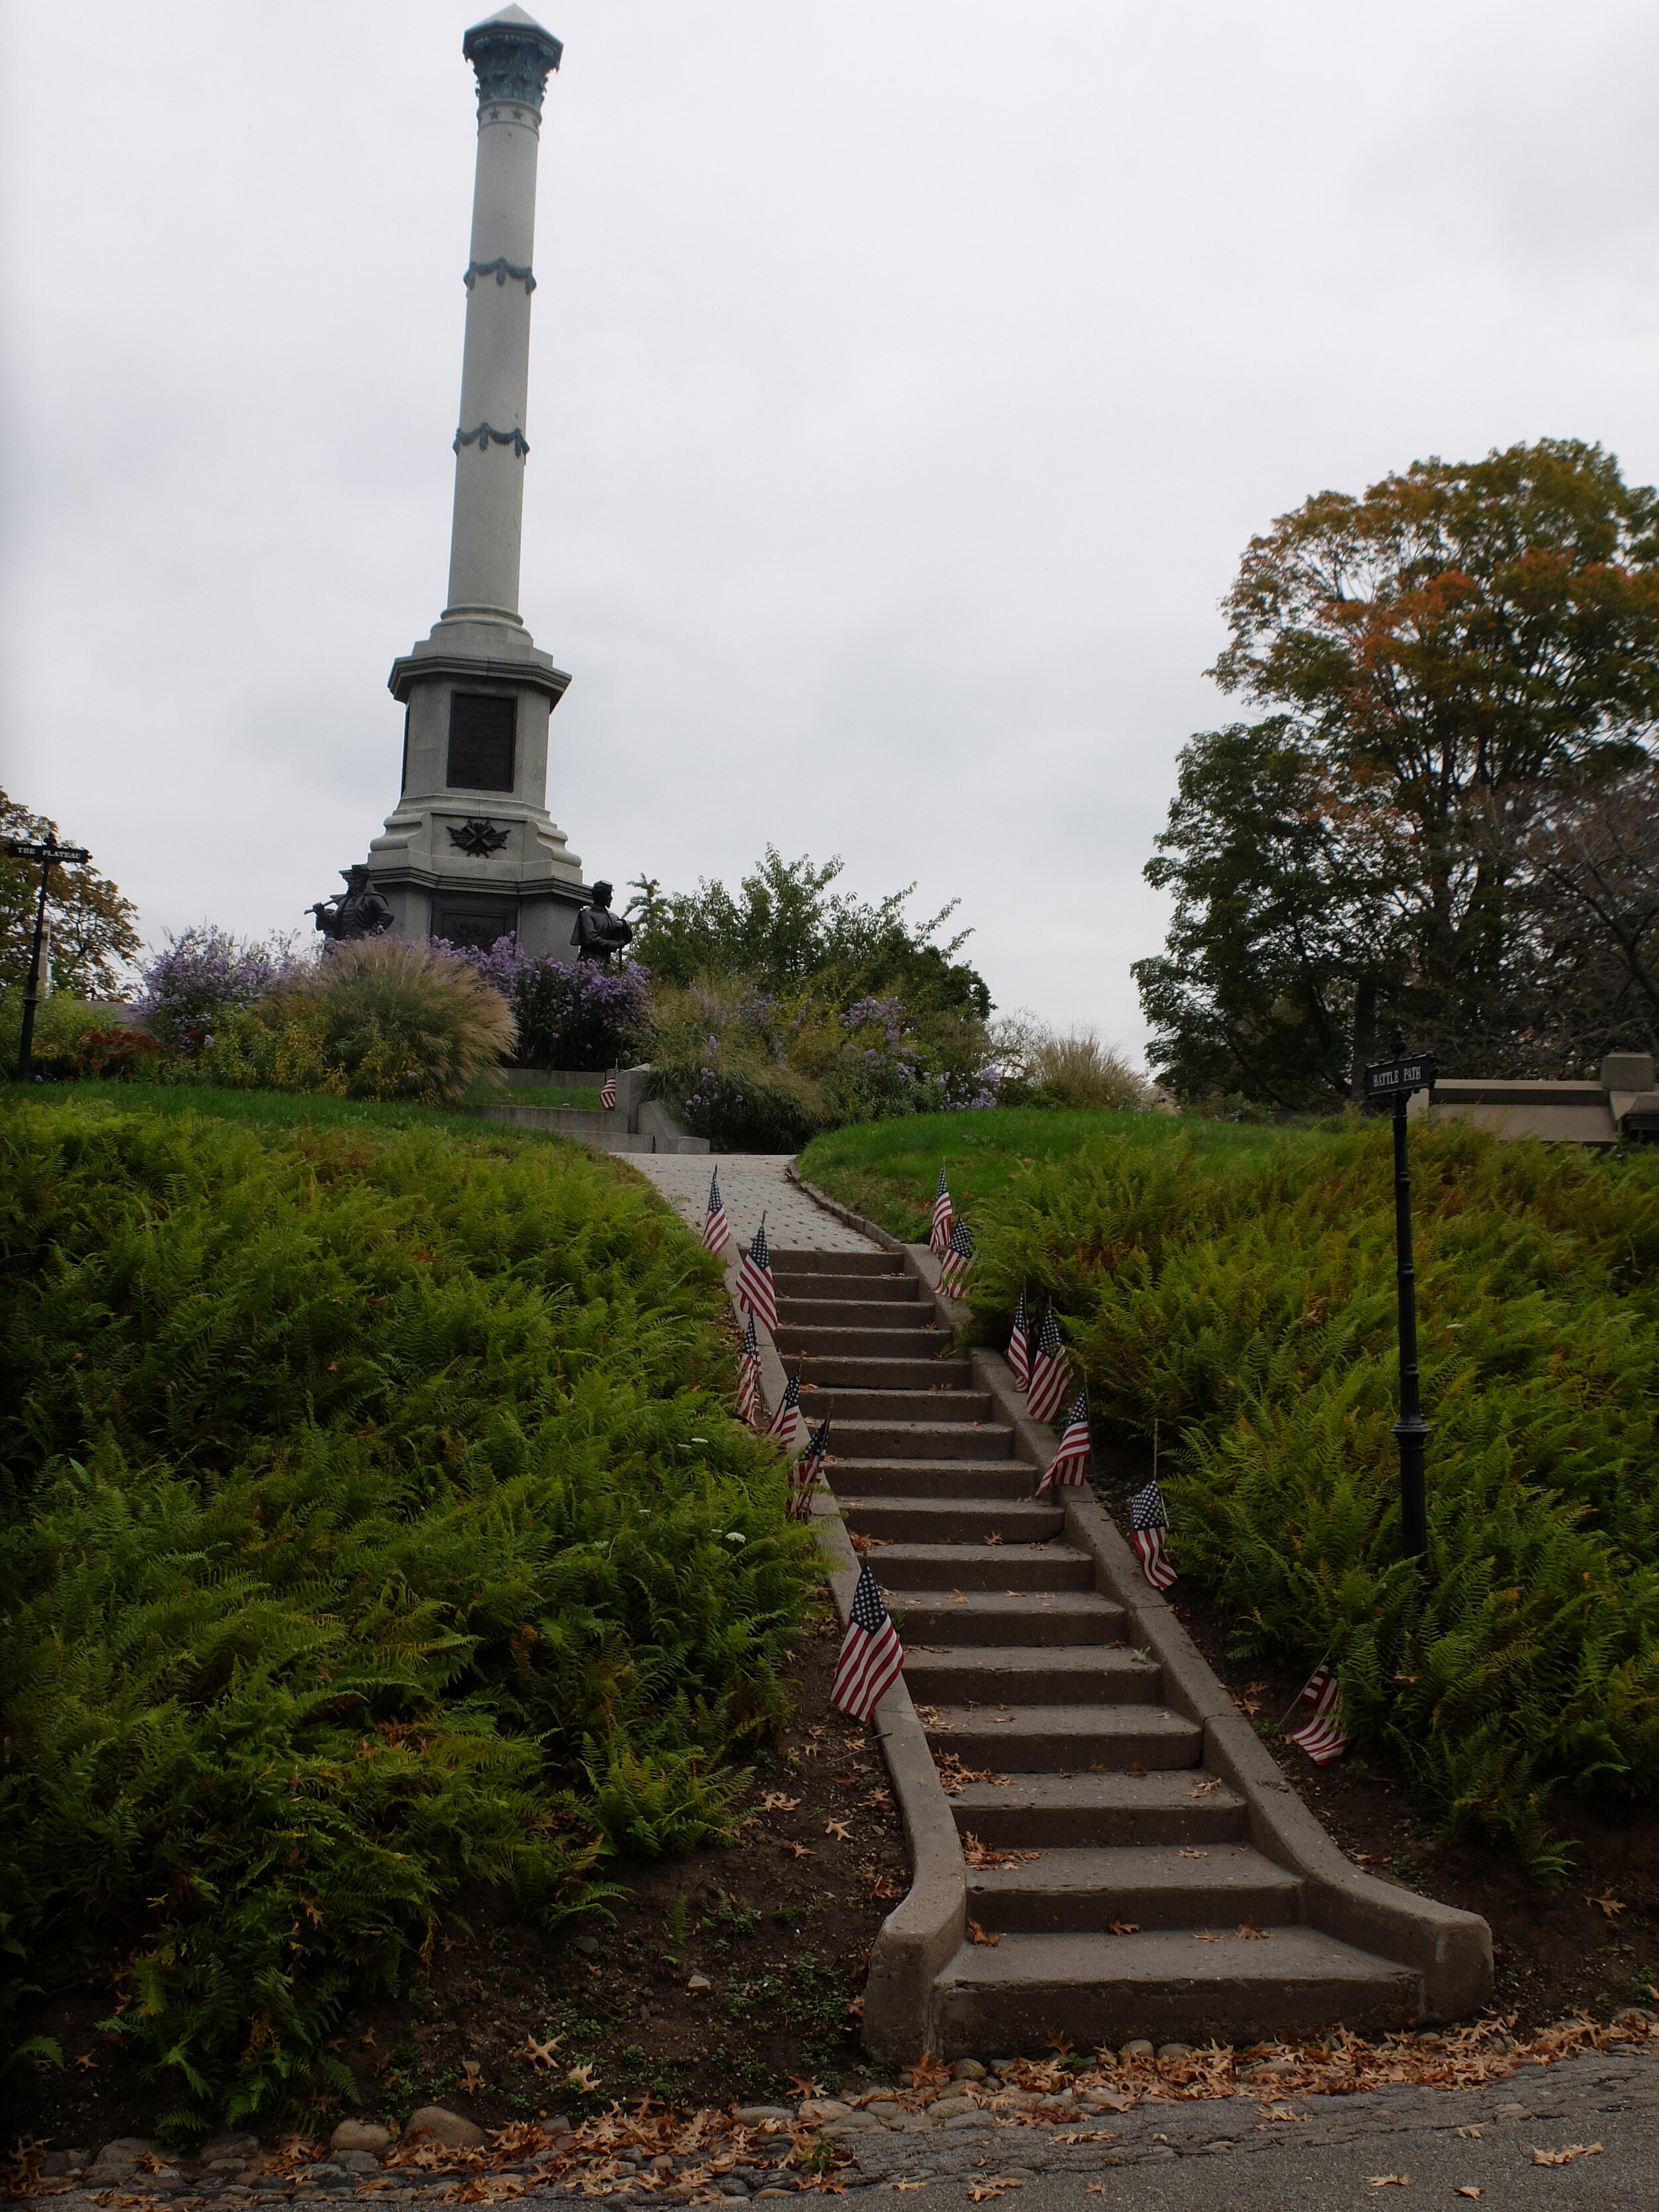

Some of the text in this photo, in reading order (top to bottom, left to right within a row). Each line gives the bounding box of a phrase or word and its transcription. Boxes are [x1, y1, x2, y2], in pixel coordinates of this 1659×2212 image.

[42, 849, 81, 859] PLATEAU
[1374, 1067, 1421, 1087] BATTLE PATH
